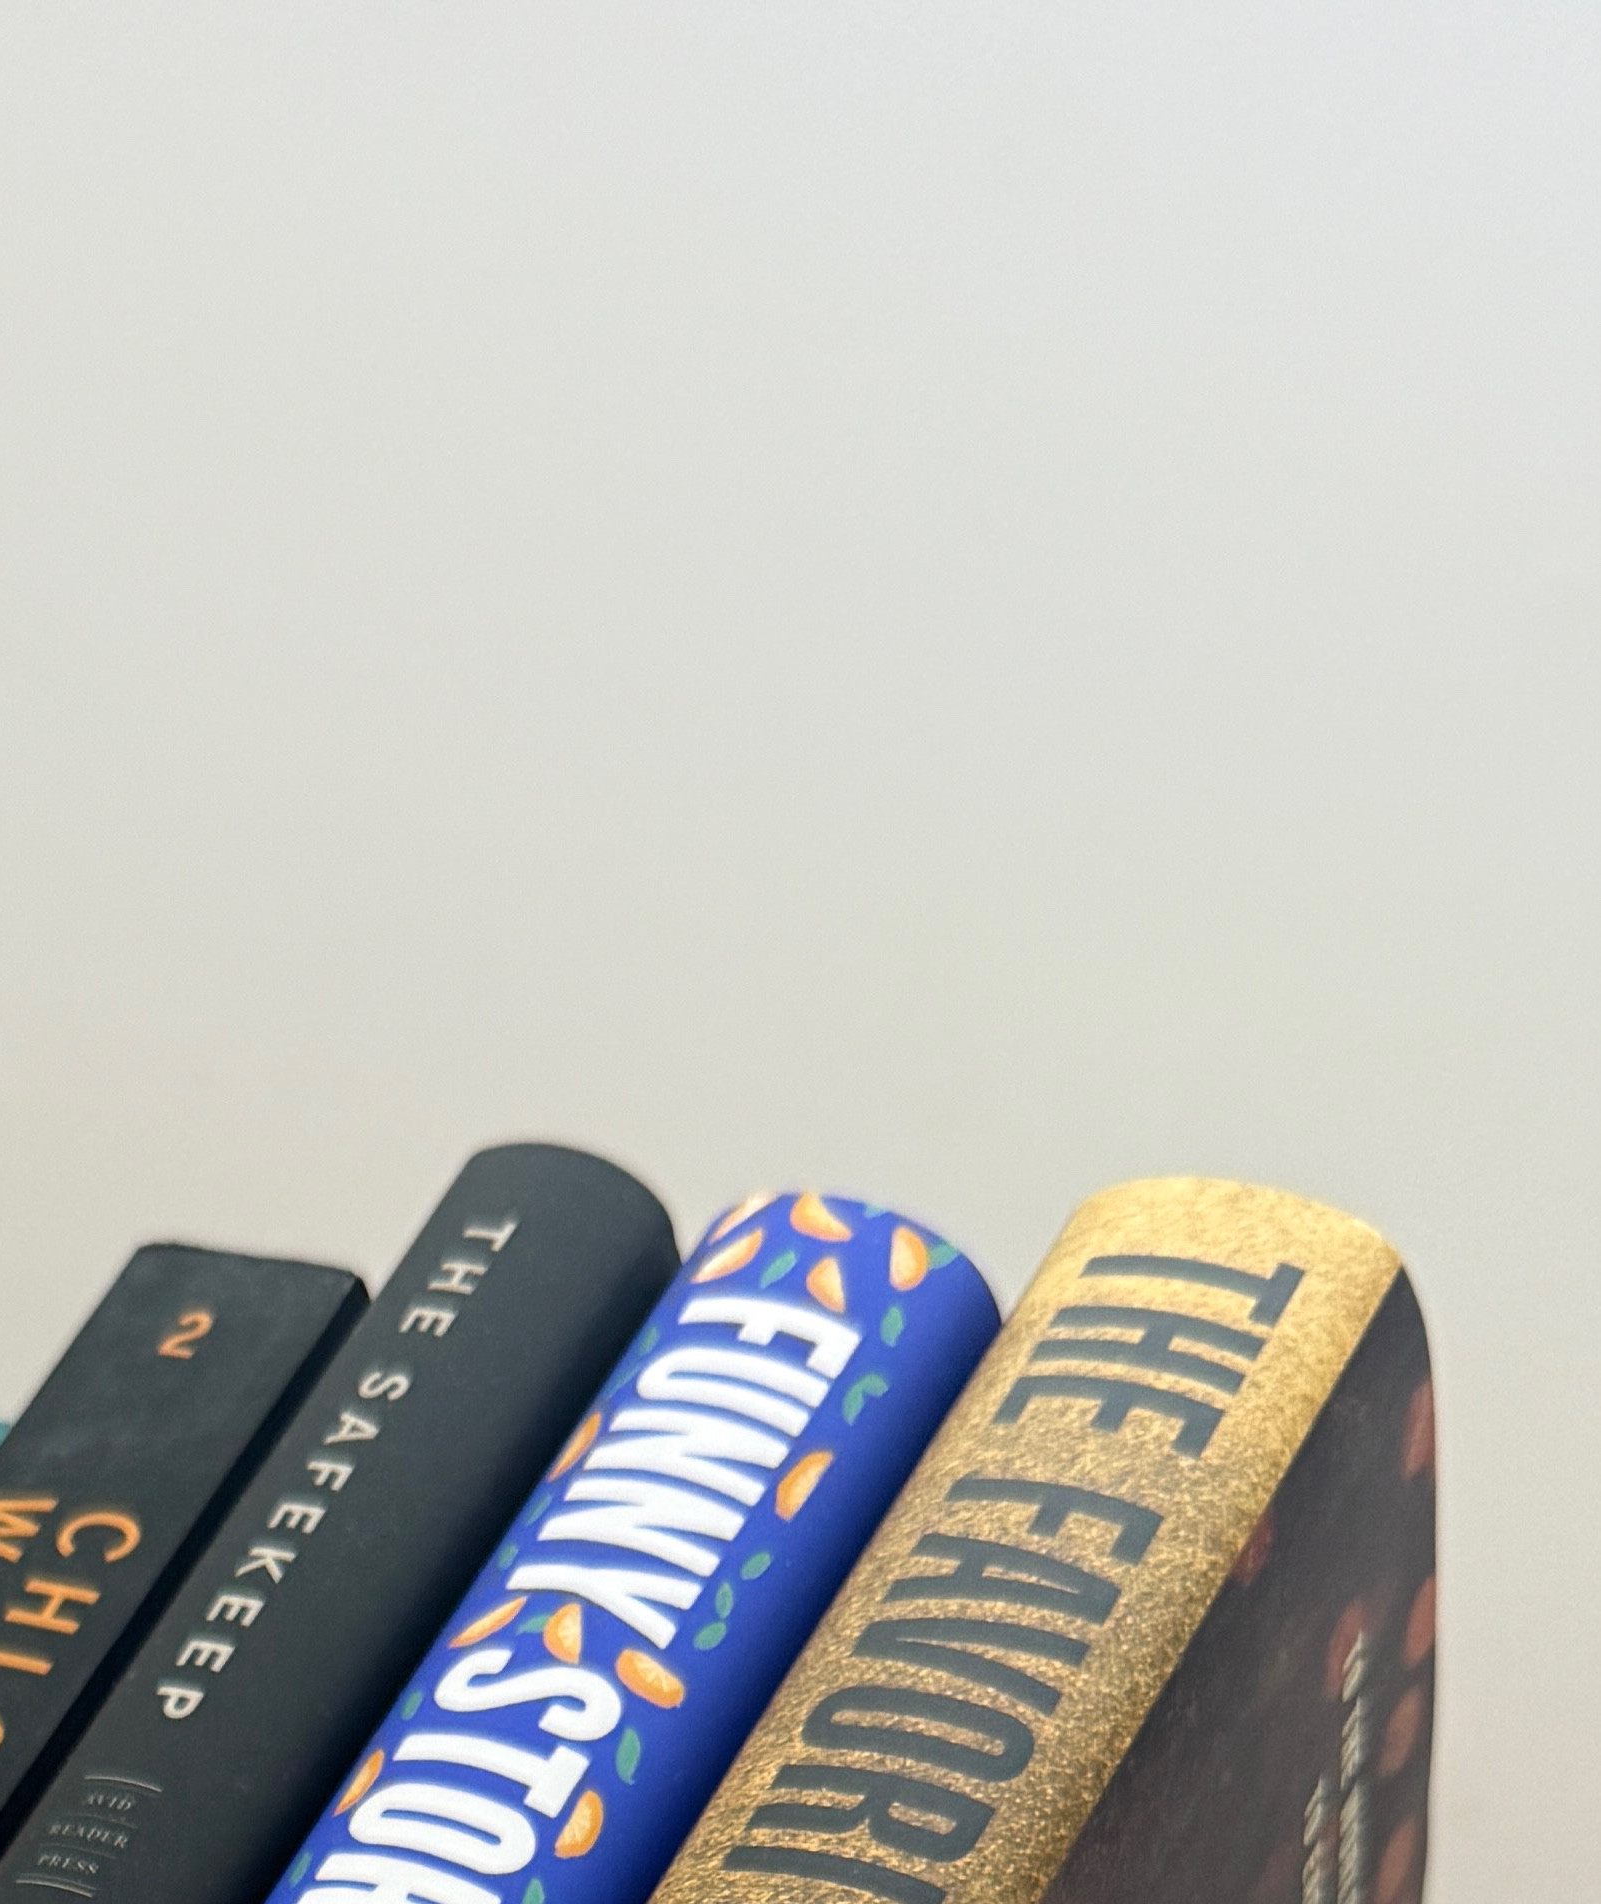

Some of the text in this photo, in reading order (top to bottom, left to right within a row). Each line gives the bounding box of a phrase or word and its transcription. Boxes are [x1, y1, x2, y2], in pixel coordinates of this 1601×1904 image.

[155, 1309, 216, 1360] 2
[994, 1252, 1307, 1460] THE
[155, 1214, 521, 1723] THE SAFEKEEP
[507, 1295, 863, 1652] FUNNY
[37, 1854, 99, 1875] PRESS
[49, 1822, 129, 1849] READER
